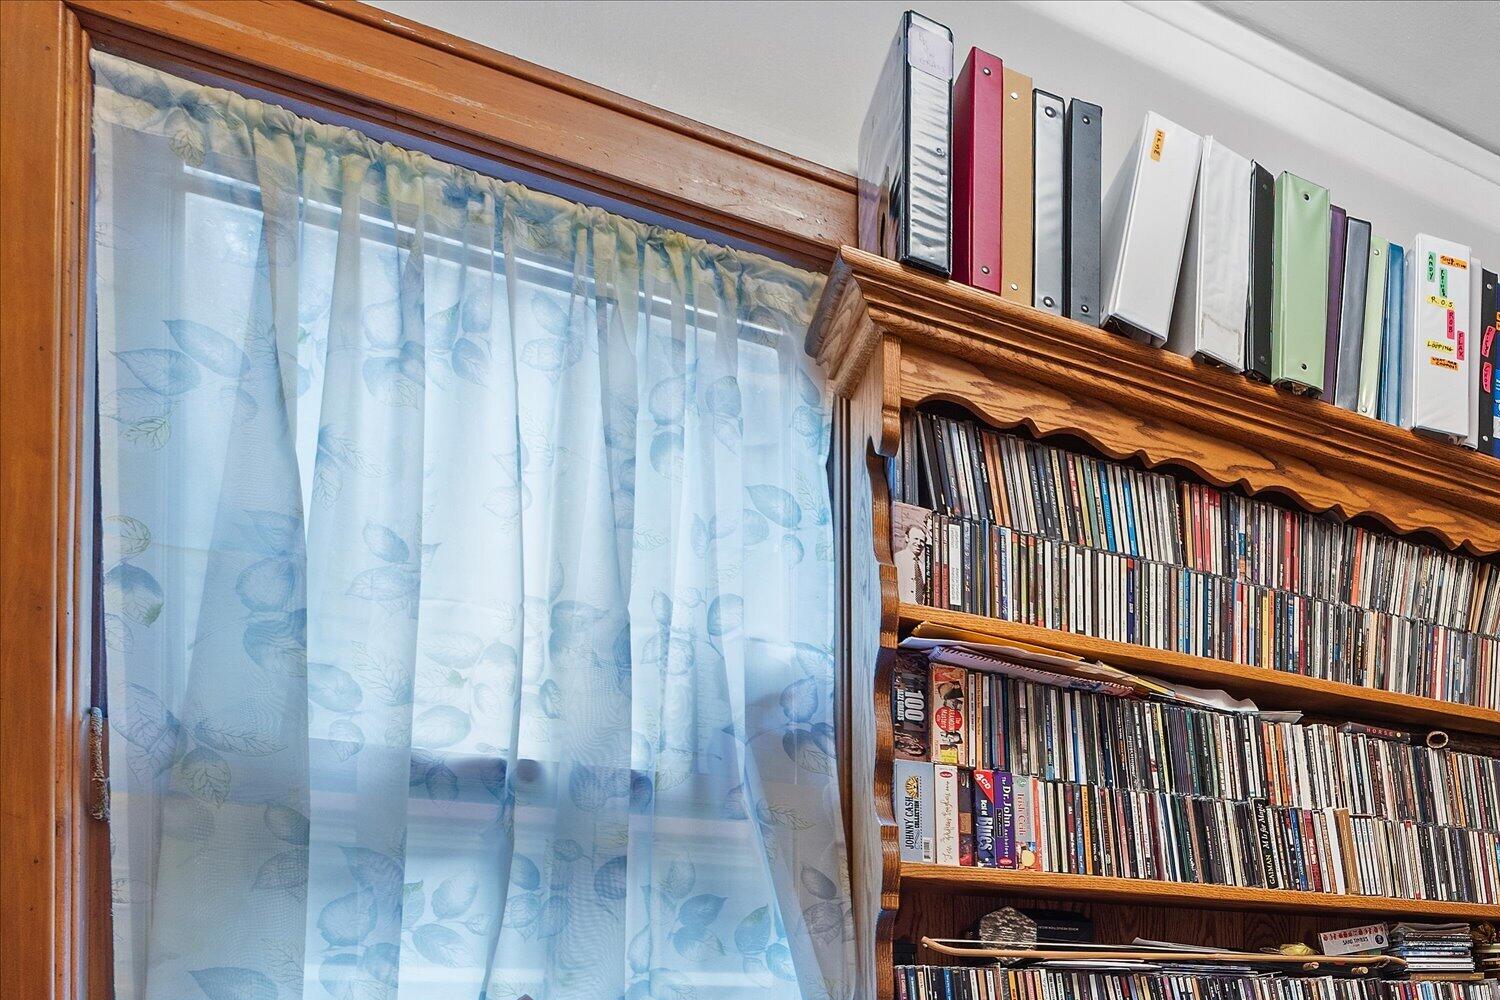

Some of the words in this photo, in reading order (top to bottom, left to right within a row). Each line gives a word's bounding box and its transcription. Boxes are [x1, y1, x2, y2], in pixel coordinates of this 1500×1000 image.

[904, 690, 925, 722] 100
[1366, 728, 1393, 736] HORSE
[976, 773, 990, 790] 4CD
[905, 796, 914, 816] CASH
[1003, 802, 1011, 827] John
[905, 817, 914, 849] JOHNNY
[976, 816, 993, 851] Blues
[1265, 855, 1275, 885] GAIMAN
